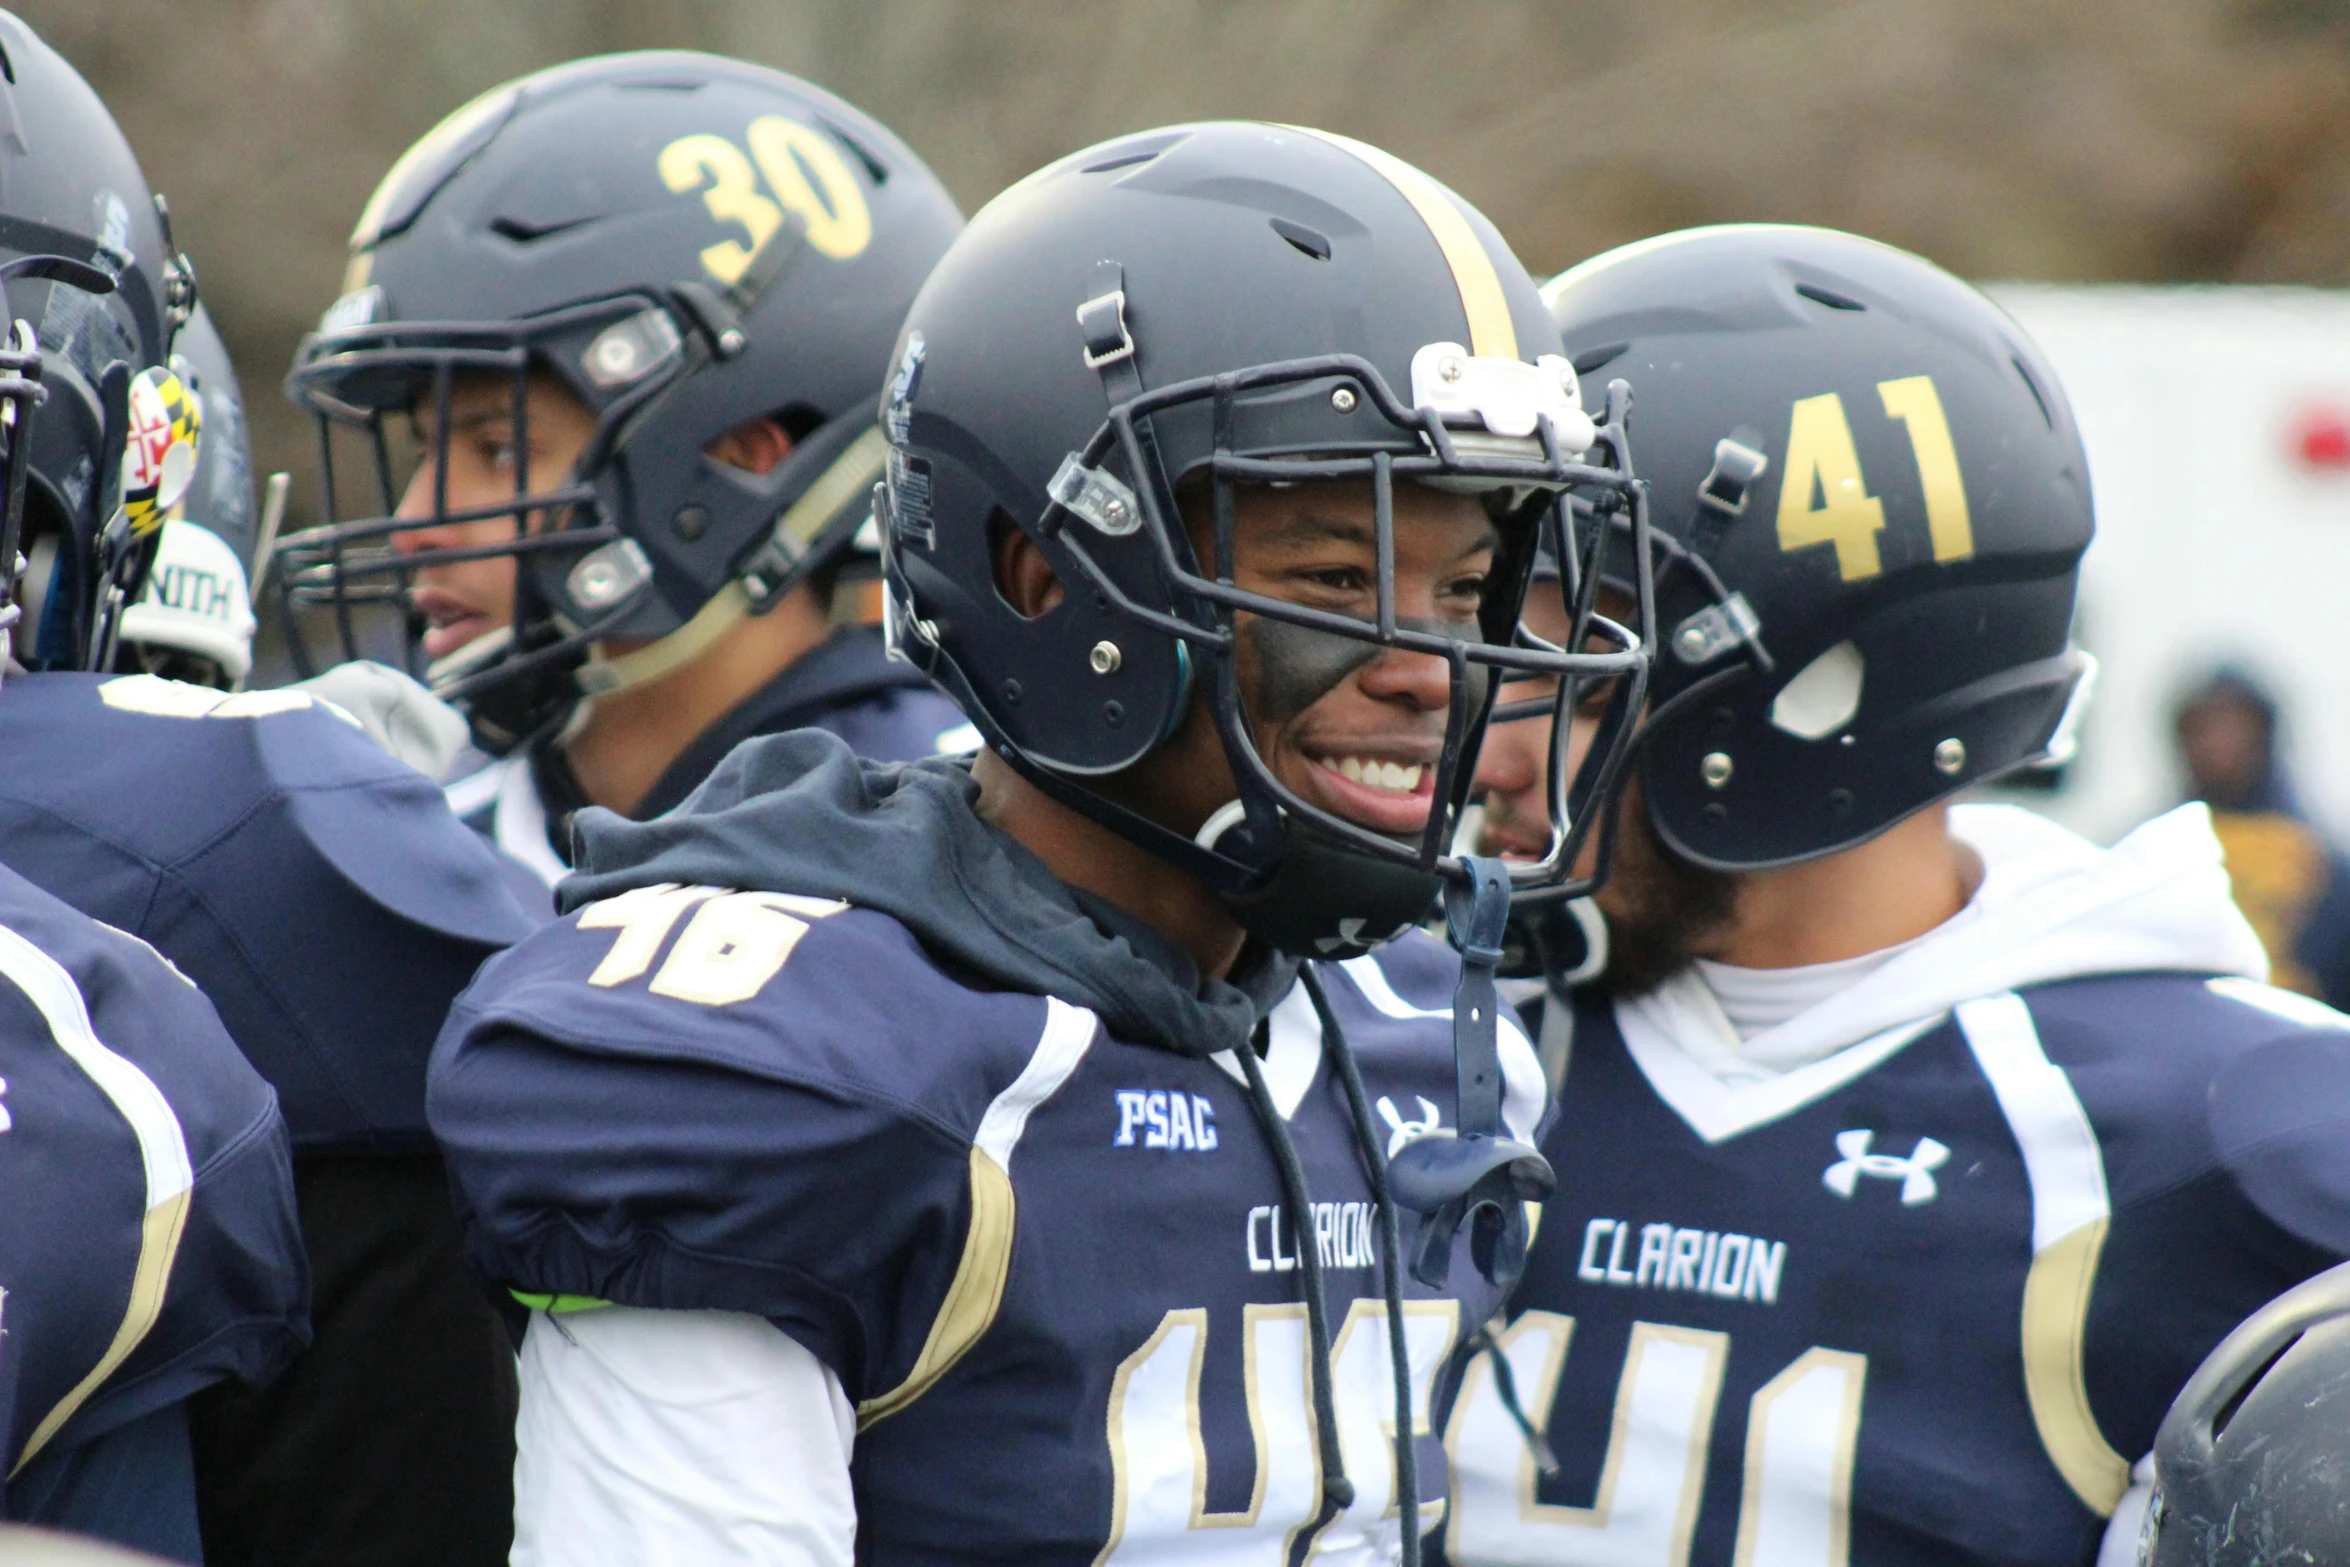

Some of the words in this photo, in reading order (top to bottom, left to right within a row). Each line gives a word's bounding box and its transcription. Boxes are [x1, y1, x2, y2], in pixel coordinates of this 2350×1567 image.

[657, 113, 872, 288] 30
[1776, 374, 1976, 583] 41
[1113, 1088, 1219, 1151] PSAC
[1577, 1217, 1788, 1304] CLARION
[1443, 1308, 1868, 1567] 41
